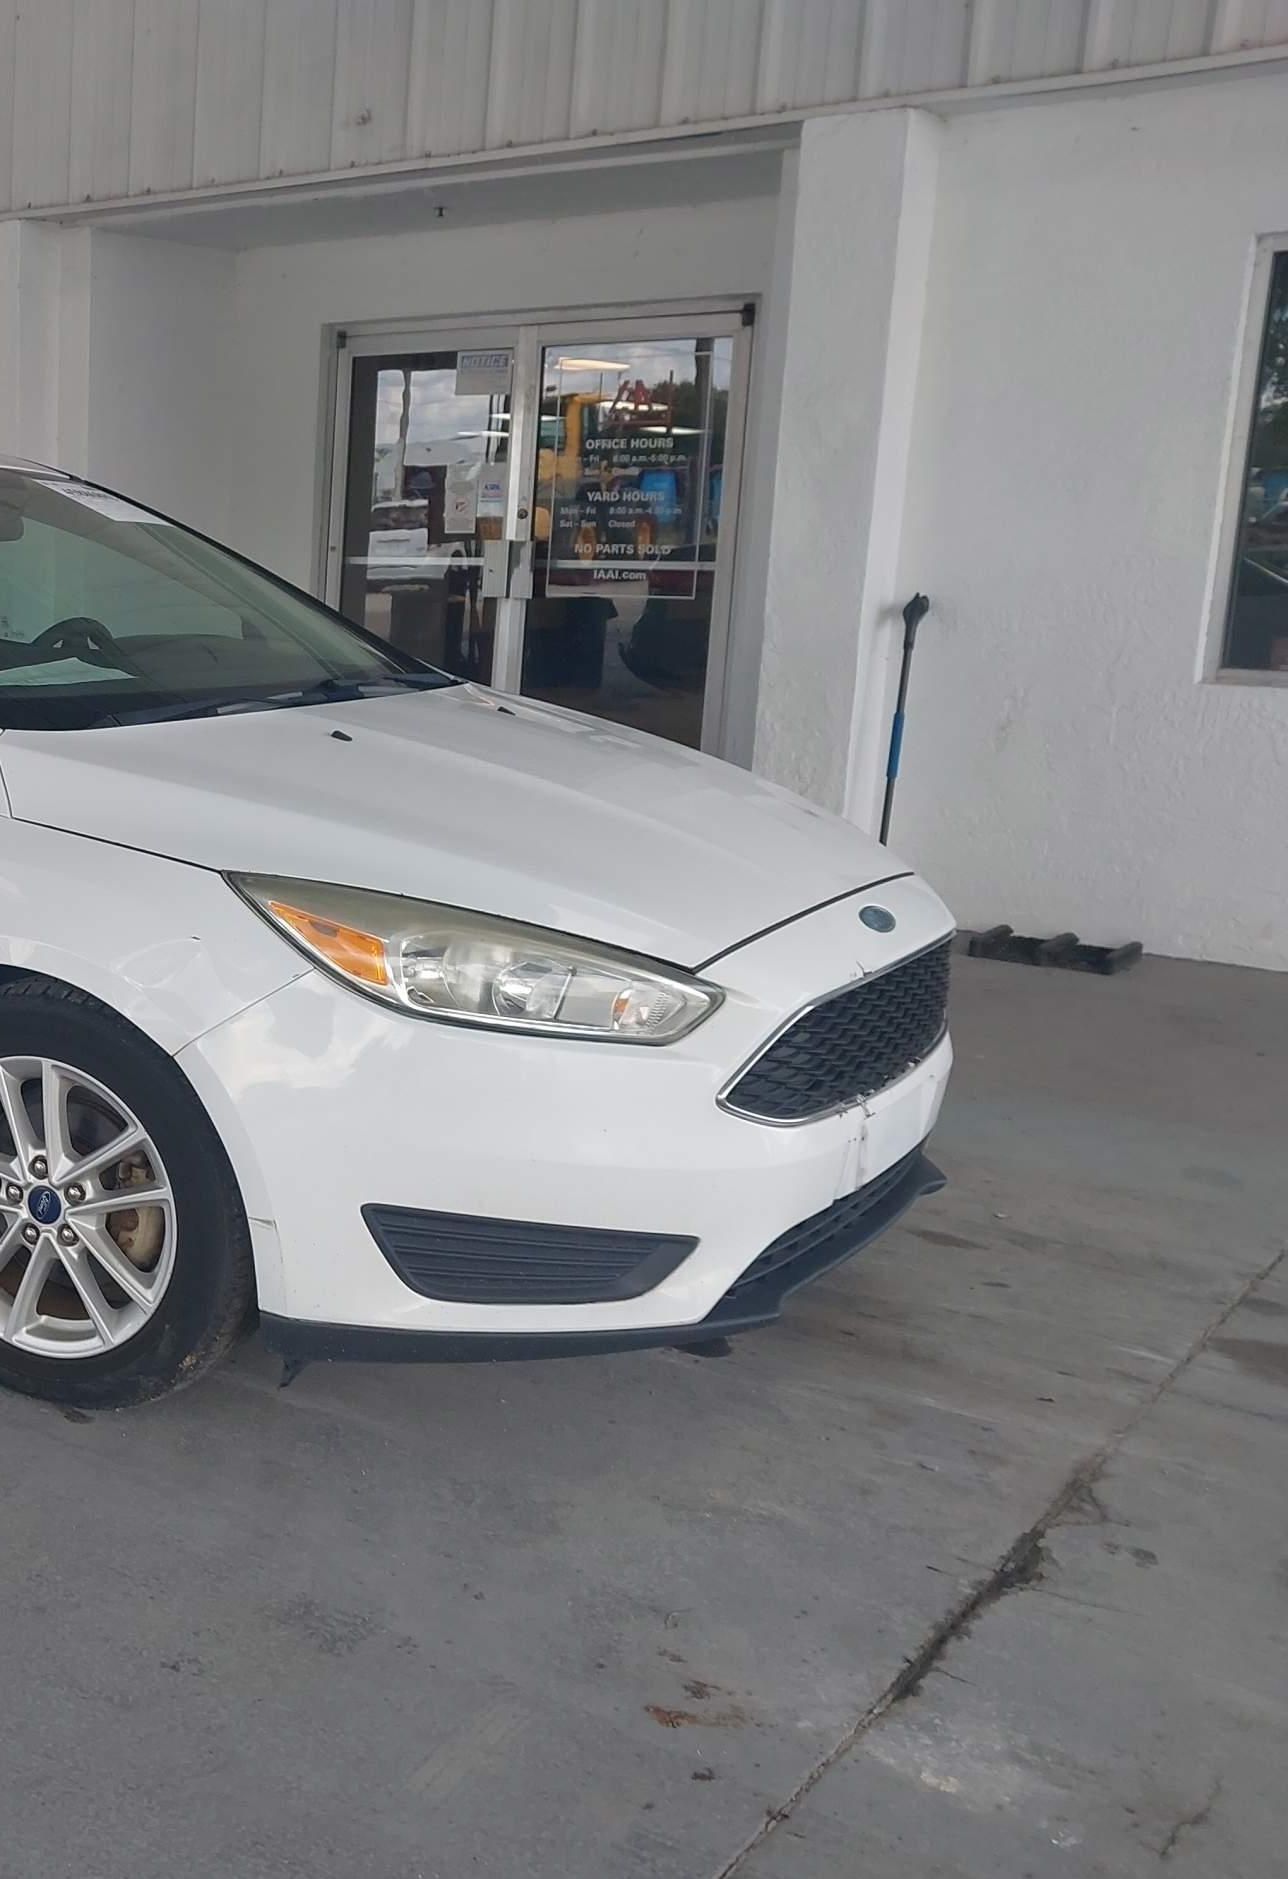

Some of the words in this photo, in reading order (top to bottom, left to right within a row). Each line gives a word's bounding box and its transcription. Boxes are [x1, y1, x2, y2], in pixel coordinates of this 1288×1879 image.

[585, 438, 627, 449] OFFICE
[630, 437, 674, 449] HOURS
[587, 491, 620, 502] YARD
[623, 490, 665, 501] HOURS
[608, 519, 636, 528] Closed
[574, 543, 592, 554] NO
[596, 543, 634, 554] PARTS
[638, 543, 672, 555] SOLD
